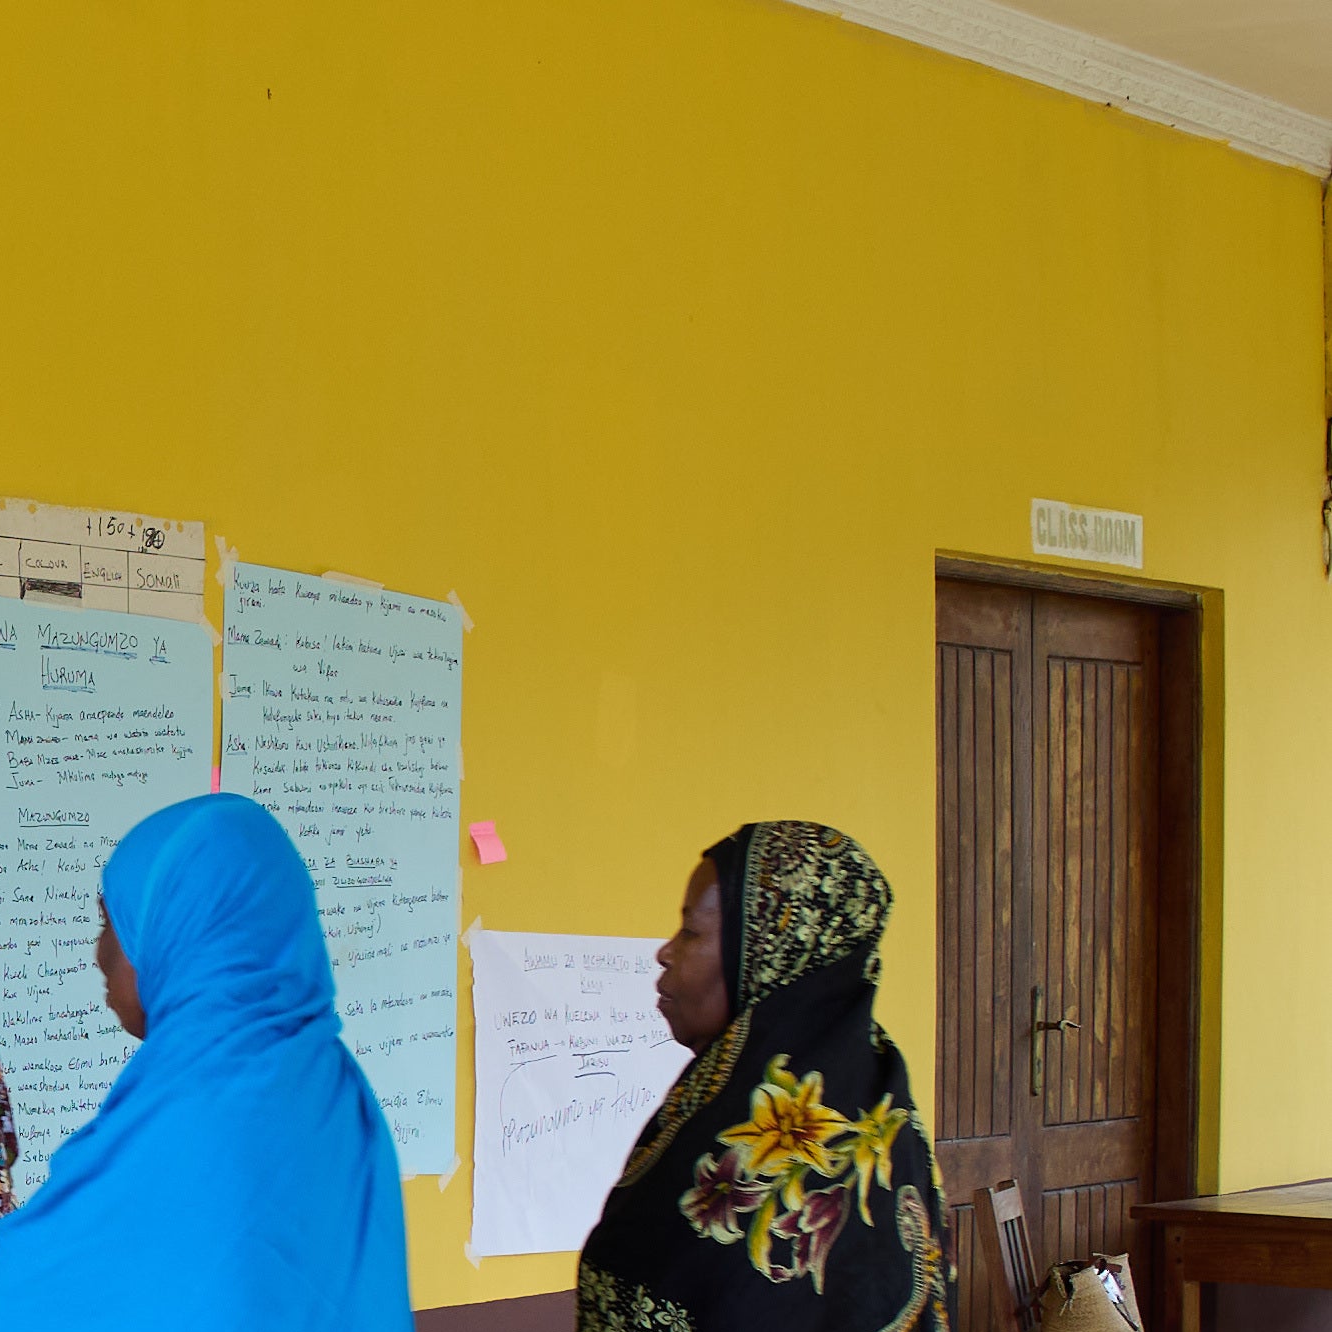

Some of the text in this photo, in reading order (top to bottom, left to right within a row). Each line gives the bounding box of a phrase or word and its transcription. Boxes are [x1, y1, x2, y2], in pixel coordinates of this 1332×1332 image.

[1037, 507, 1135, 558] CLASS ROOM
[37, 623, 138, 650] MAZUNGUMZO
[153, 636, 168, 657] YA
[41, 654, 96, 686] HURUMA
[18, 807, 89, 823] MAZUNGUMZO
[494, 1012, 537, 1030] UWEZO
[545, 1009, 558, 1020] WA
[606, 1033, 633, 1046] WAZO
